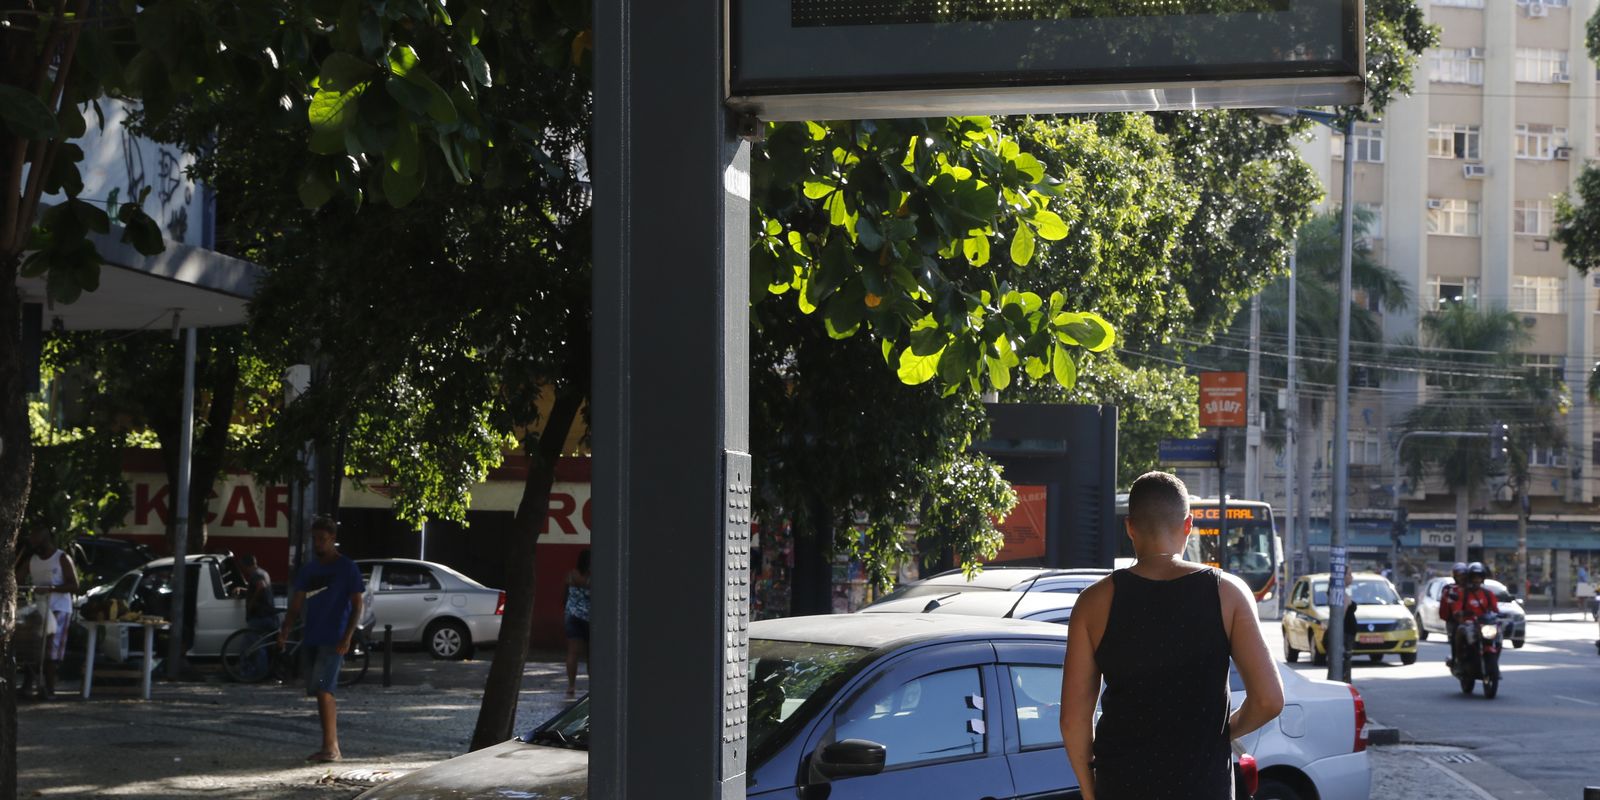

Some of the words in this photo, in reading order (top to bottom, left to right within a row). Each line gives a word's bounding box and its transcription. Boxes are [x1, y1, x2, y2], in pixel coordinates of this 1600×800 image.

[1219, 400, 1241, 414] LOFT
[539, 493, 591, 534] R
[1429, 534, 1474, 543] mau
